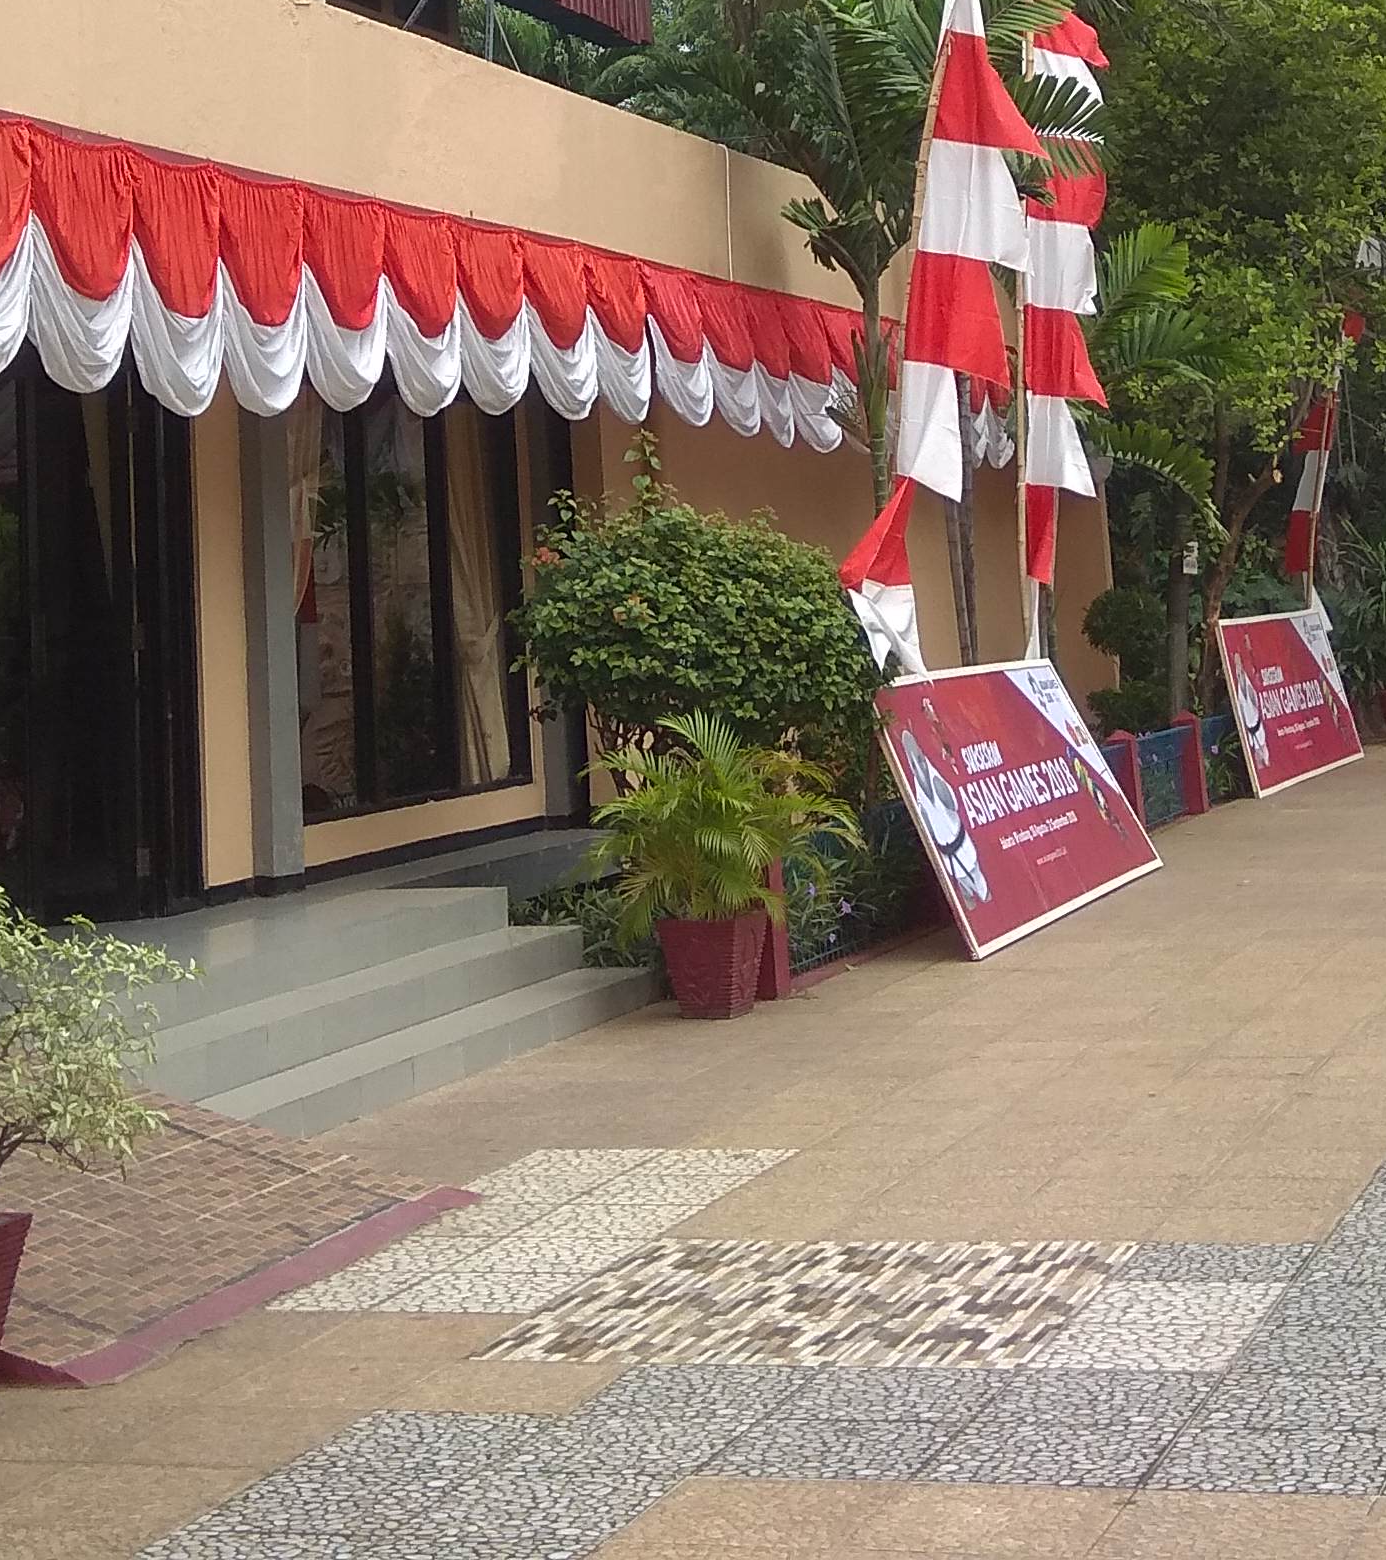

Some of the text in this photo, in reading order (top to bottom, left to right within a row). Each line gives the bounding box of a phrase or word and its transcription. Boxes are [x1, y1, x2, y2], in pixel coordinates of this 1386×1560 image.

[1258, 687, 1284, 720] ASIAN
[1279, 682, 1307, 714] GAMES
[958, 756, 1079, 829] ASIAN GAMES 2018
